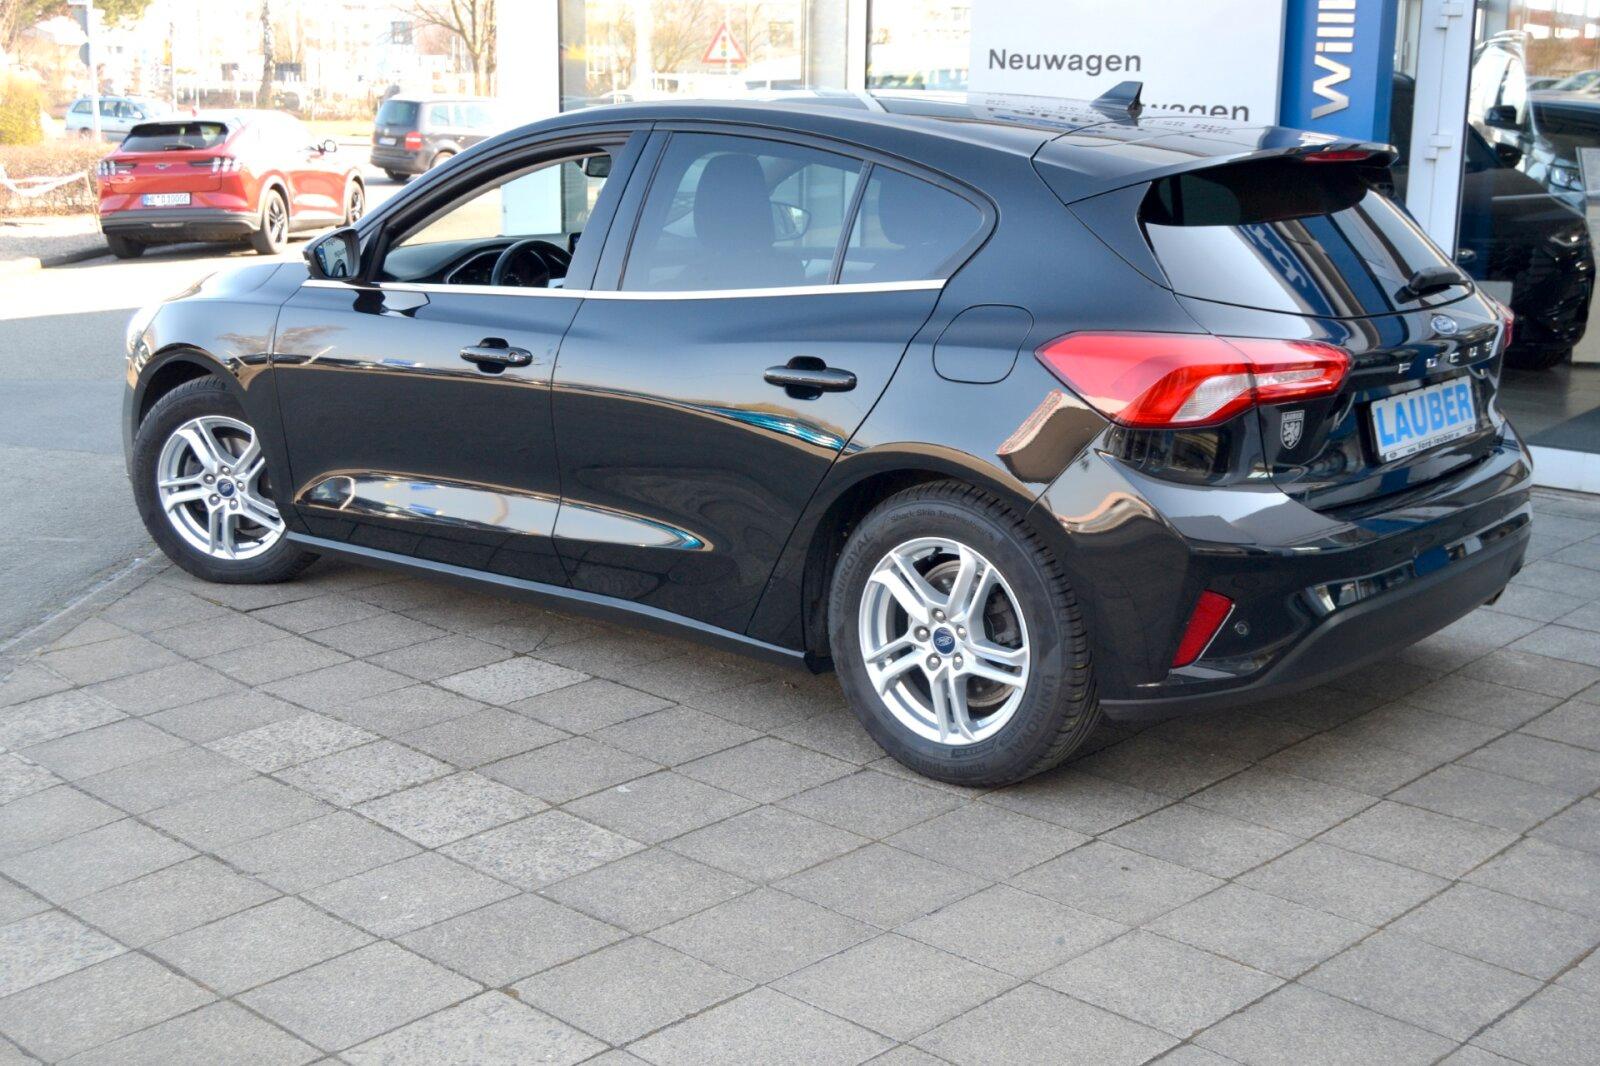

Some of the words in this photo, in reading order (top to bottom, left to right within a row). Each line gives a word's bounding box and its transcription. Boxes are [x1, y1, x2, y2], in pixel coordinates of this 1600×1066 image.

[988, 48, 1141, 76] Neuwagen
[1397, 341, 1493, 374] FOCUS
[1376, 383, 1473, 447] LAUBER
[833, 533, 874, 613] UNIROYAL
